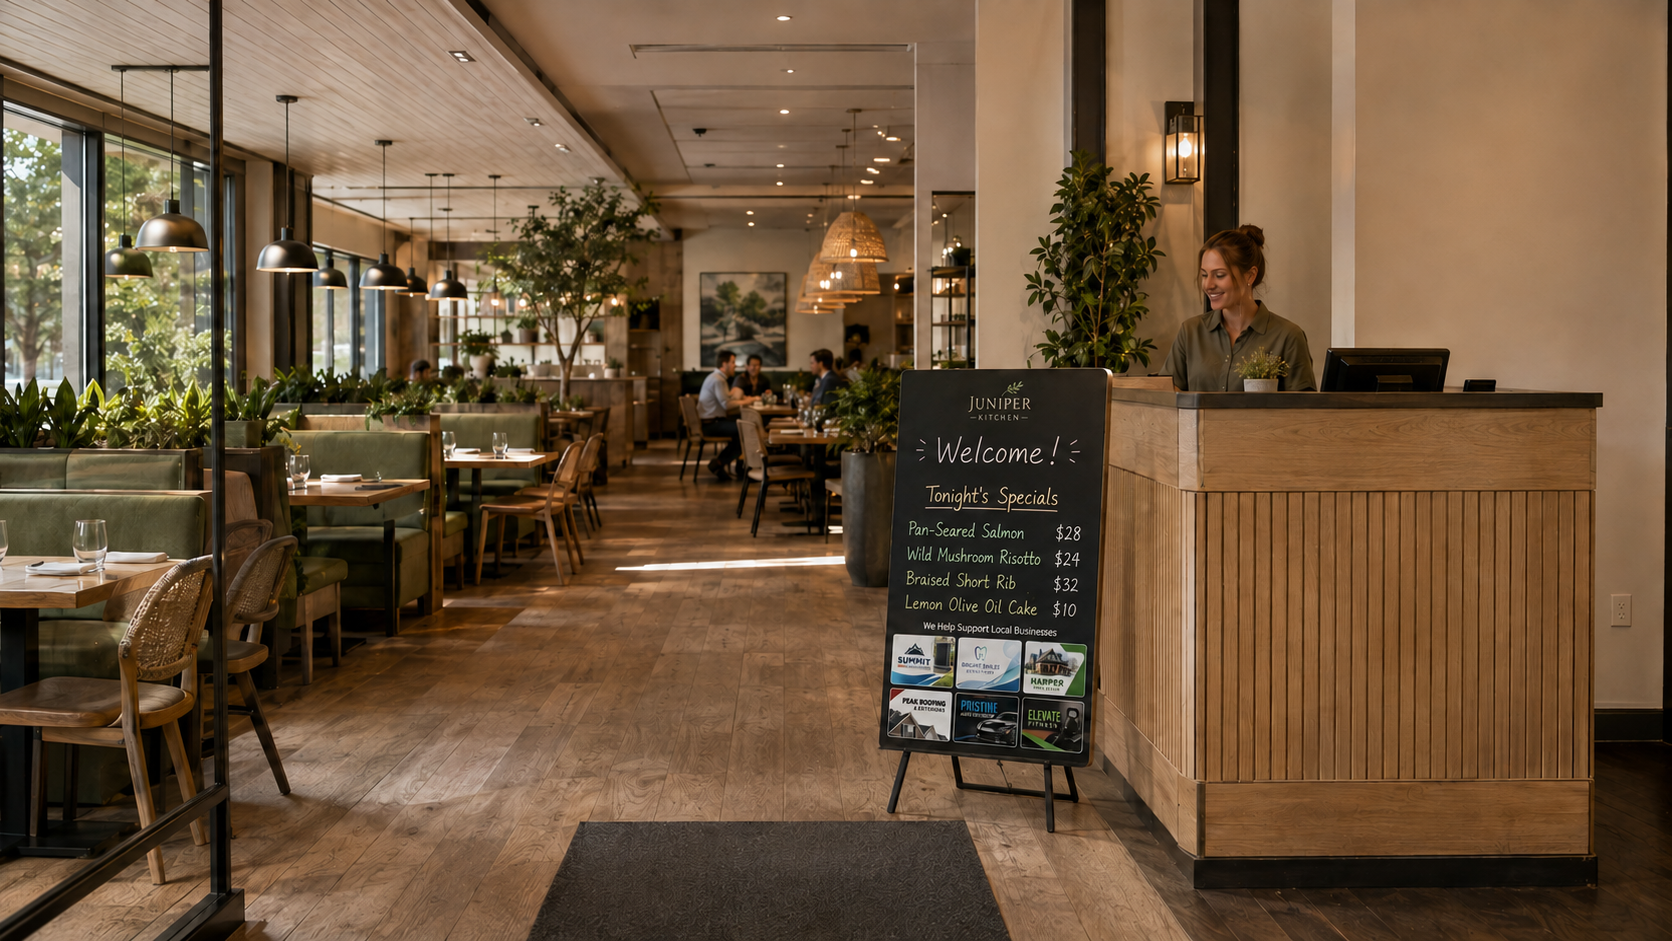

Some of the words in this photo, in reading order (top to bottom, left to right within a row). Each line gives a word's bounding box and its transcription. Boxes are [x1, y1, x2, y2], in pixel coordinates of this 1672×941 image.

[968, 396, 1031, 412] JUNIPER
[925, 485, 989, 511] Tonight's
[997, 486, 1058, 513] Specials
[908, 521, 976, 538] Pan-Seared
[982, 523, 1025, 540] Salmon
[1056, 524, 1082, 542] $28
[907, 546, 932, 562] Wild
[937, 547, 994, 563] Mushroom
[1000, 549, 1041, 566] Risotto
[1055, 550, 1080, 567] $24
[906, 571, 950, 586] Braised
[956, 573, 990, 589] Short
[997, 574, 1016, 589] Rib
[1053, 576, 1079, 593] $32
[905, 594, 943, 610] Lemon
[949, 597, 979, 613] Olive
[985, 599, 1002, 614] Oil
[1008, 600, 1038, 616] Cake
[1053, 601, 1077, 618] $10
[923, 622, 936, 630] We
[937, 622, 955, 632] Help
[957, 623, 989, 634] Support
[991, 625, 1012, 634] Local
[1014, 626, 1057, 637] Businesses
[1031, 678, 1064, 687] HARPER
[1028, 709, 1061, 722] ELEVATE
